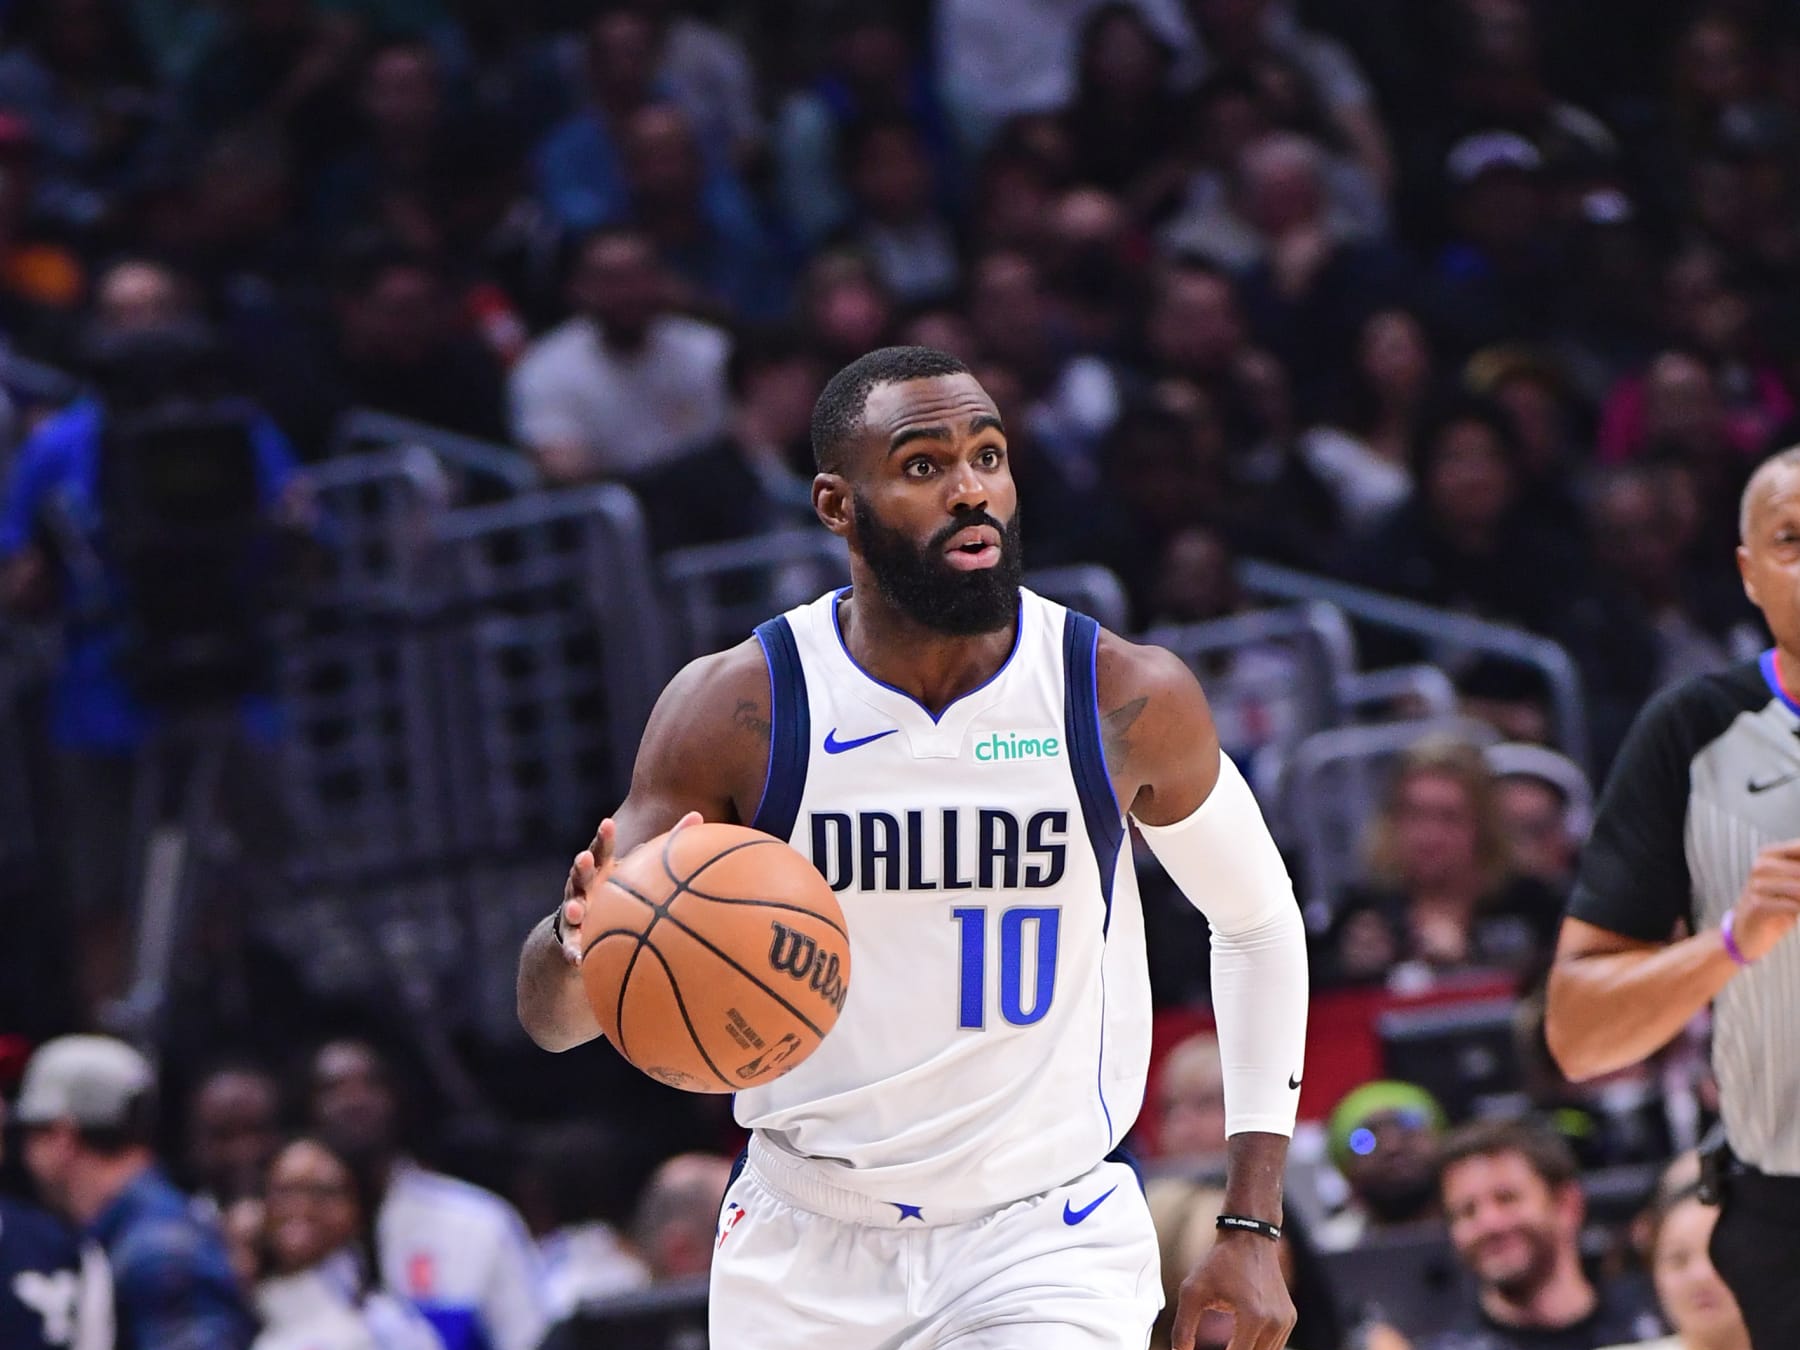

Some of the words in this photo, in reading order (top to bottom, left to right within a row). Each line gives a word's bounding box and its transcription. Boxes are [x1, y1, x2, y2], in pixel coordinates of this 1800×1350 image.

[975, 733, 1059, 760] chime
[808, 807, 1070, 893] DALLAS
[950, 905, 1062, 1031] 10
